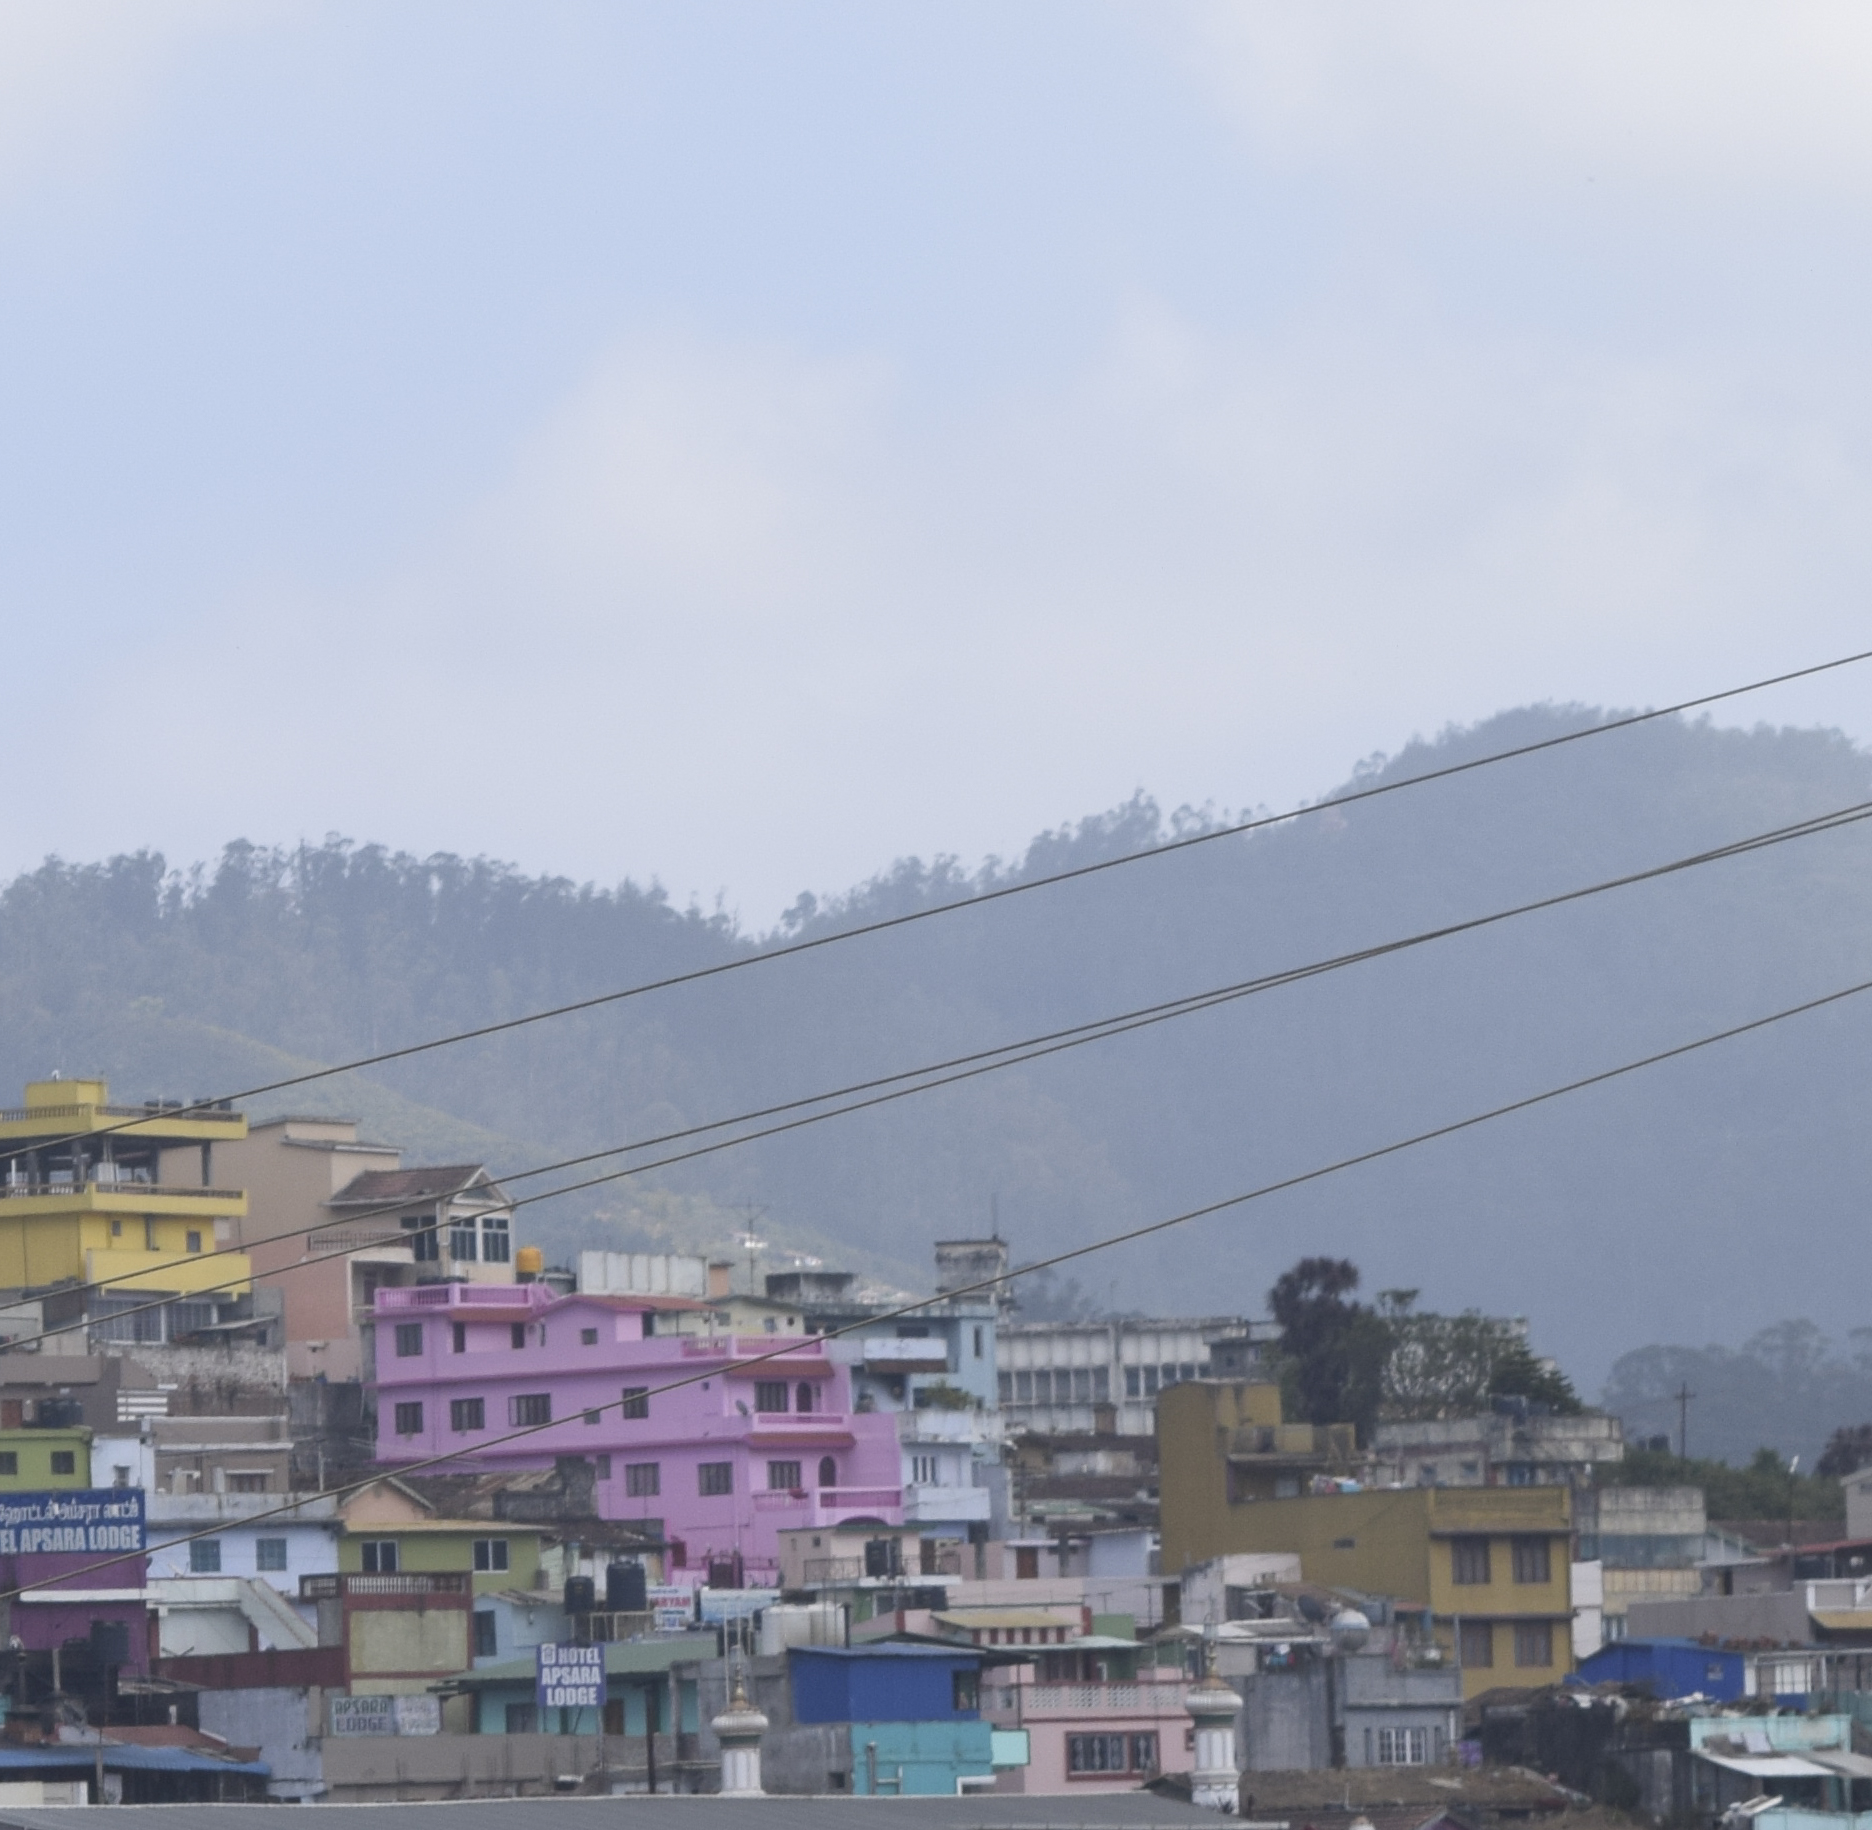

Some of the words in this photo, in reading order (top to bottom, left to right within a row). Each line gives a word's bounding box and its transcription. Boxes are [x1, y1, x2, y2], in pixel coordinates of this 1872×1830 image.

[20, 1527, 86, 1552] APSARA
[88, 1524, 140, 1551] LODGE
[557, 1648, 600, 1665] HOTEL
[541, 1666, 601, 1685] APSARA
[546, 1686, 598, 1706] LODGE
